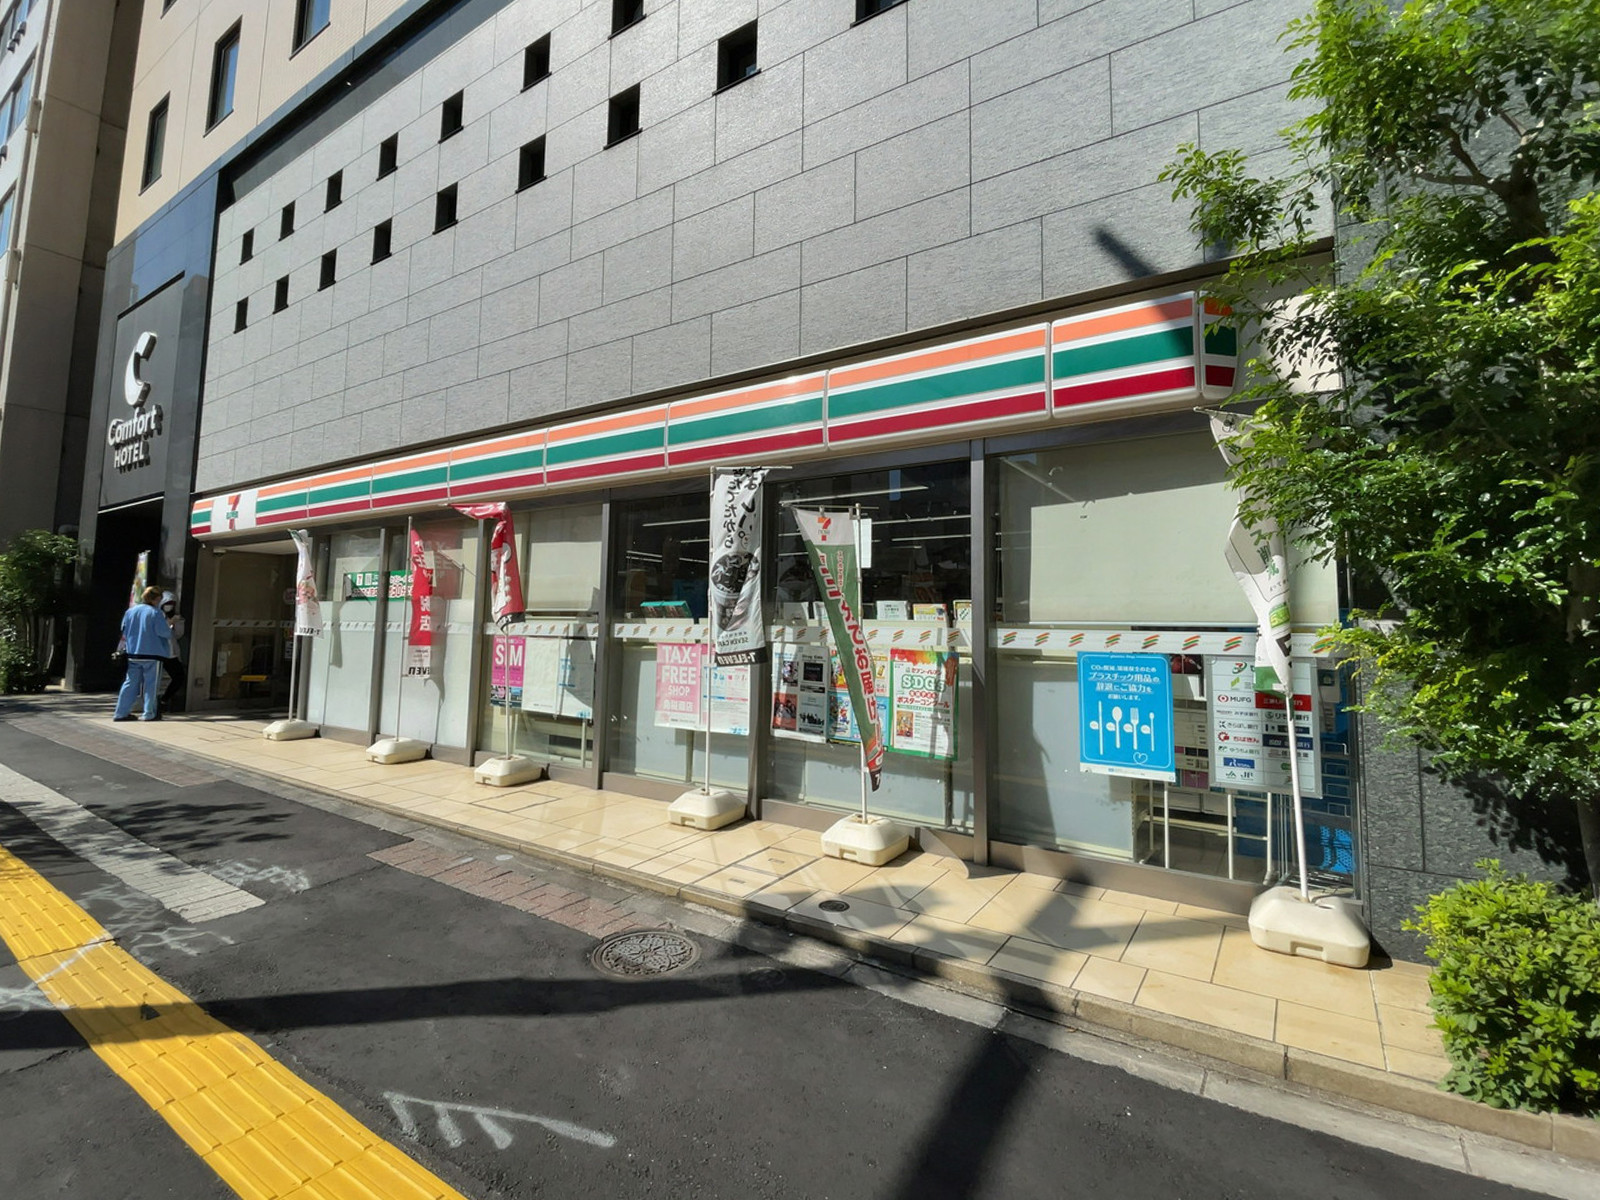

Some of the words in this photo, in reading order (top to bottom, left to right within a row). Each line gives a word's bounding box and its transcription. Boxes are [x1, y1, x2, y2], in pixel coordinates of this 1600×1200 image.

[108, 404, 158, 446] Comfort
[114, 441, 145, 468] HOTEL
[662, 665, 697, 685] FREE
[1089, 671, 1160, 684] プラスチック用品の
[668, 685, 690, 696] SHOP
[897, 696, 950, 709] ポスターコンクール
